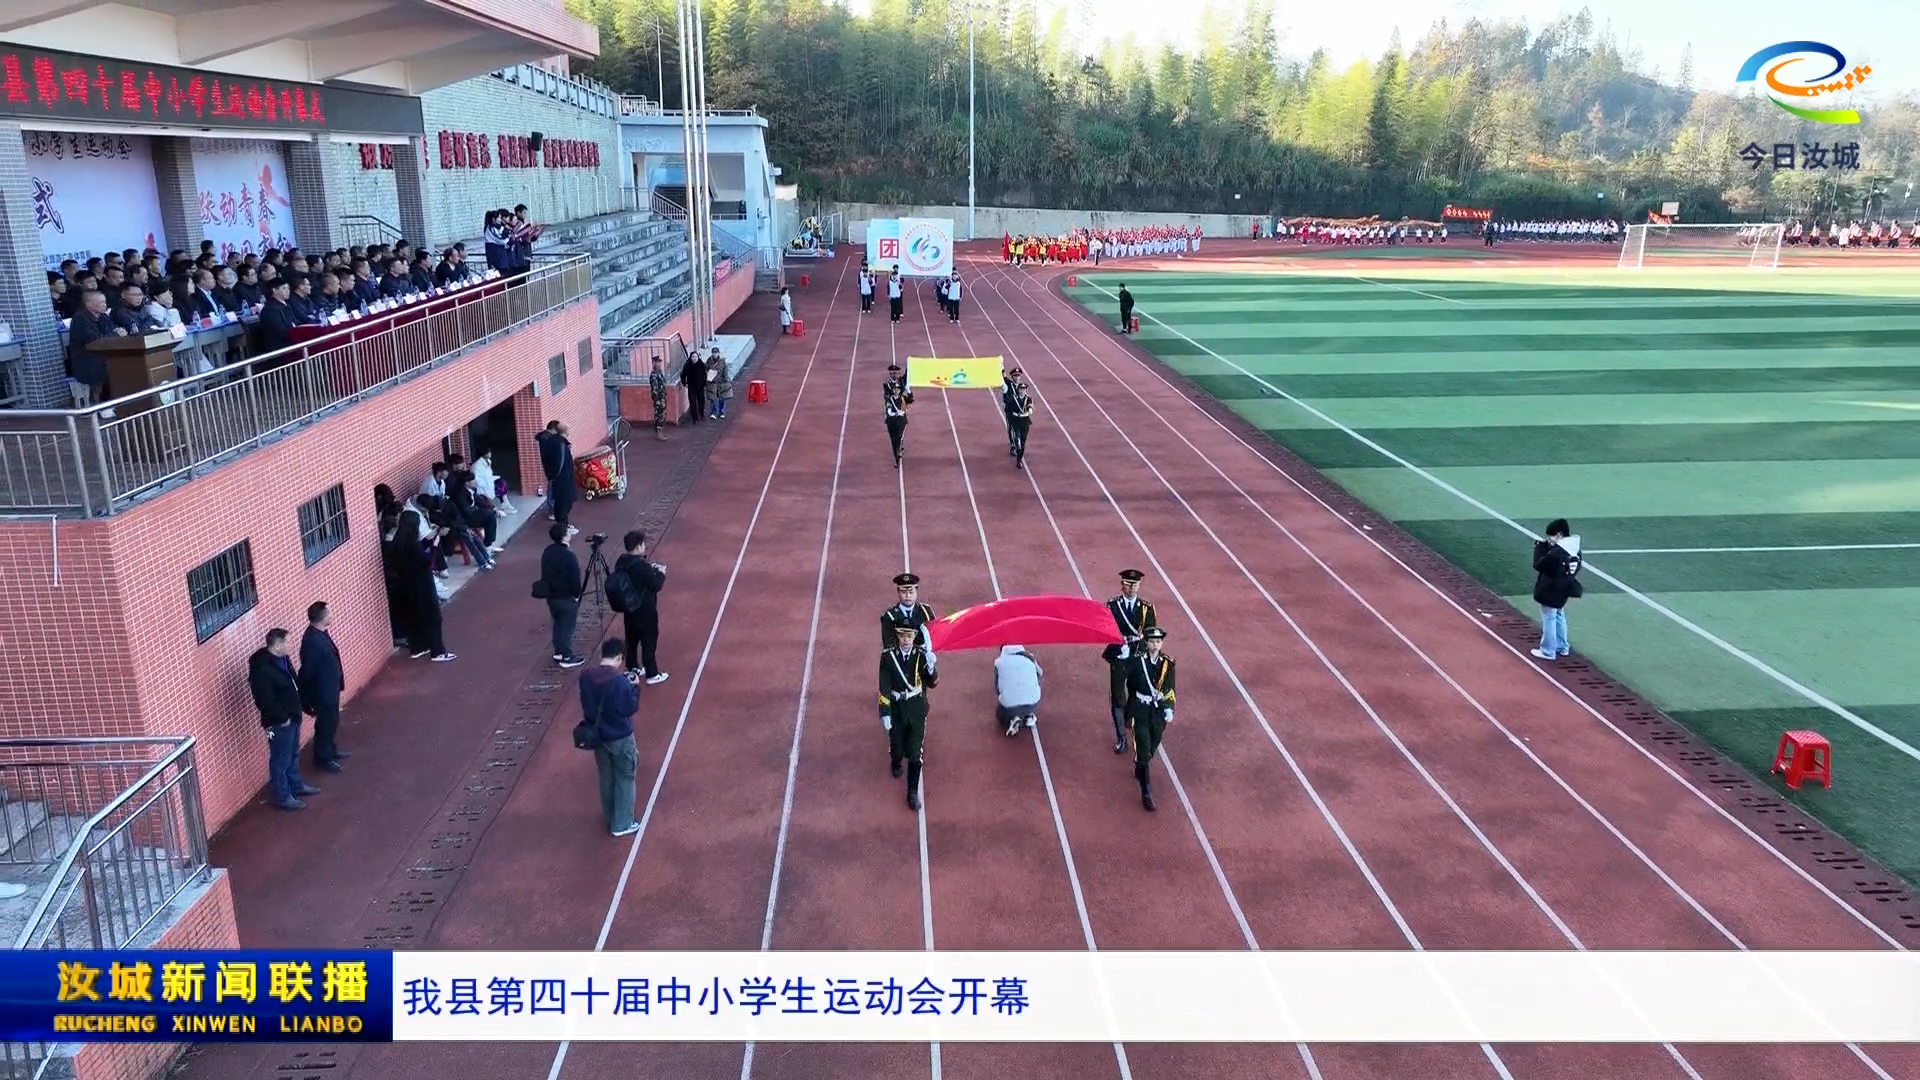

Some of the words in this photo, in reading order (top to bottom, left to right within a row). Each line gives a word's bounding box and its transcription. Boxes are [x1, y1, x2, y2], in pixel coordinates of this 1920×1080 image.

[31, 176, 65, 235] 式
[198, 182, 277, 229] 跃动青春
[879, 238, 900, 260] 团
